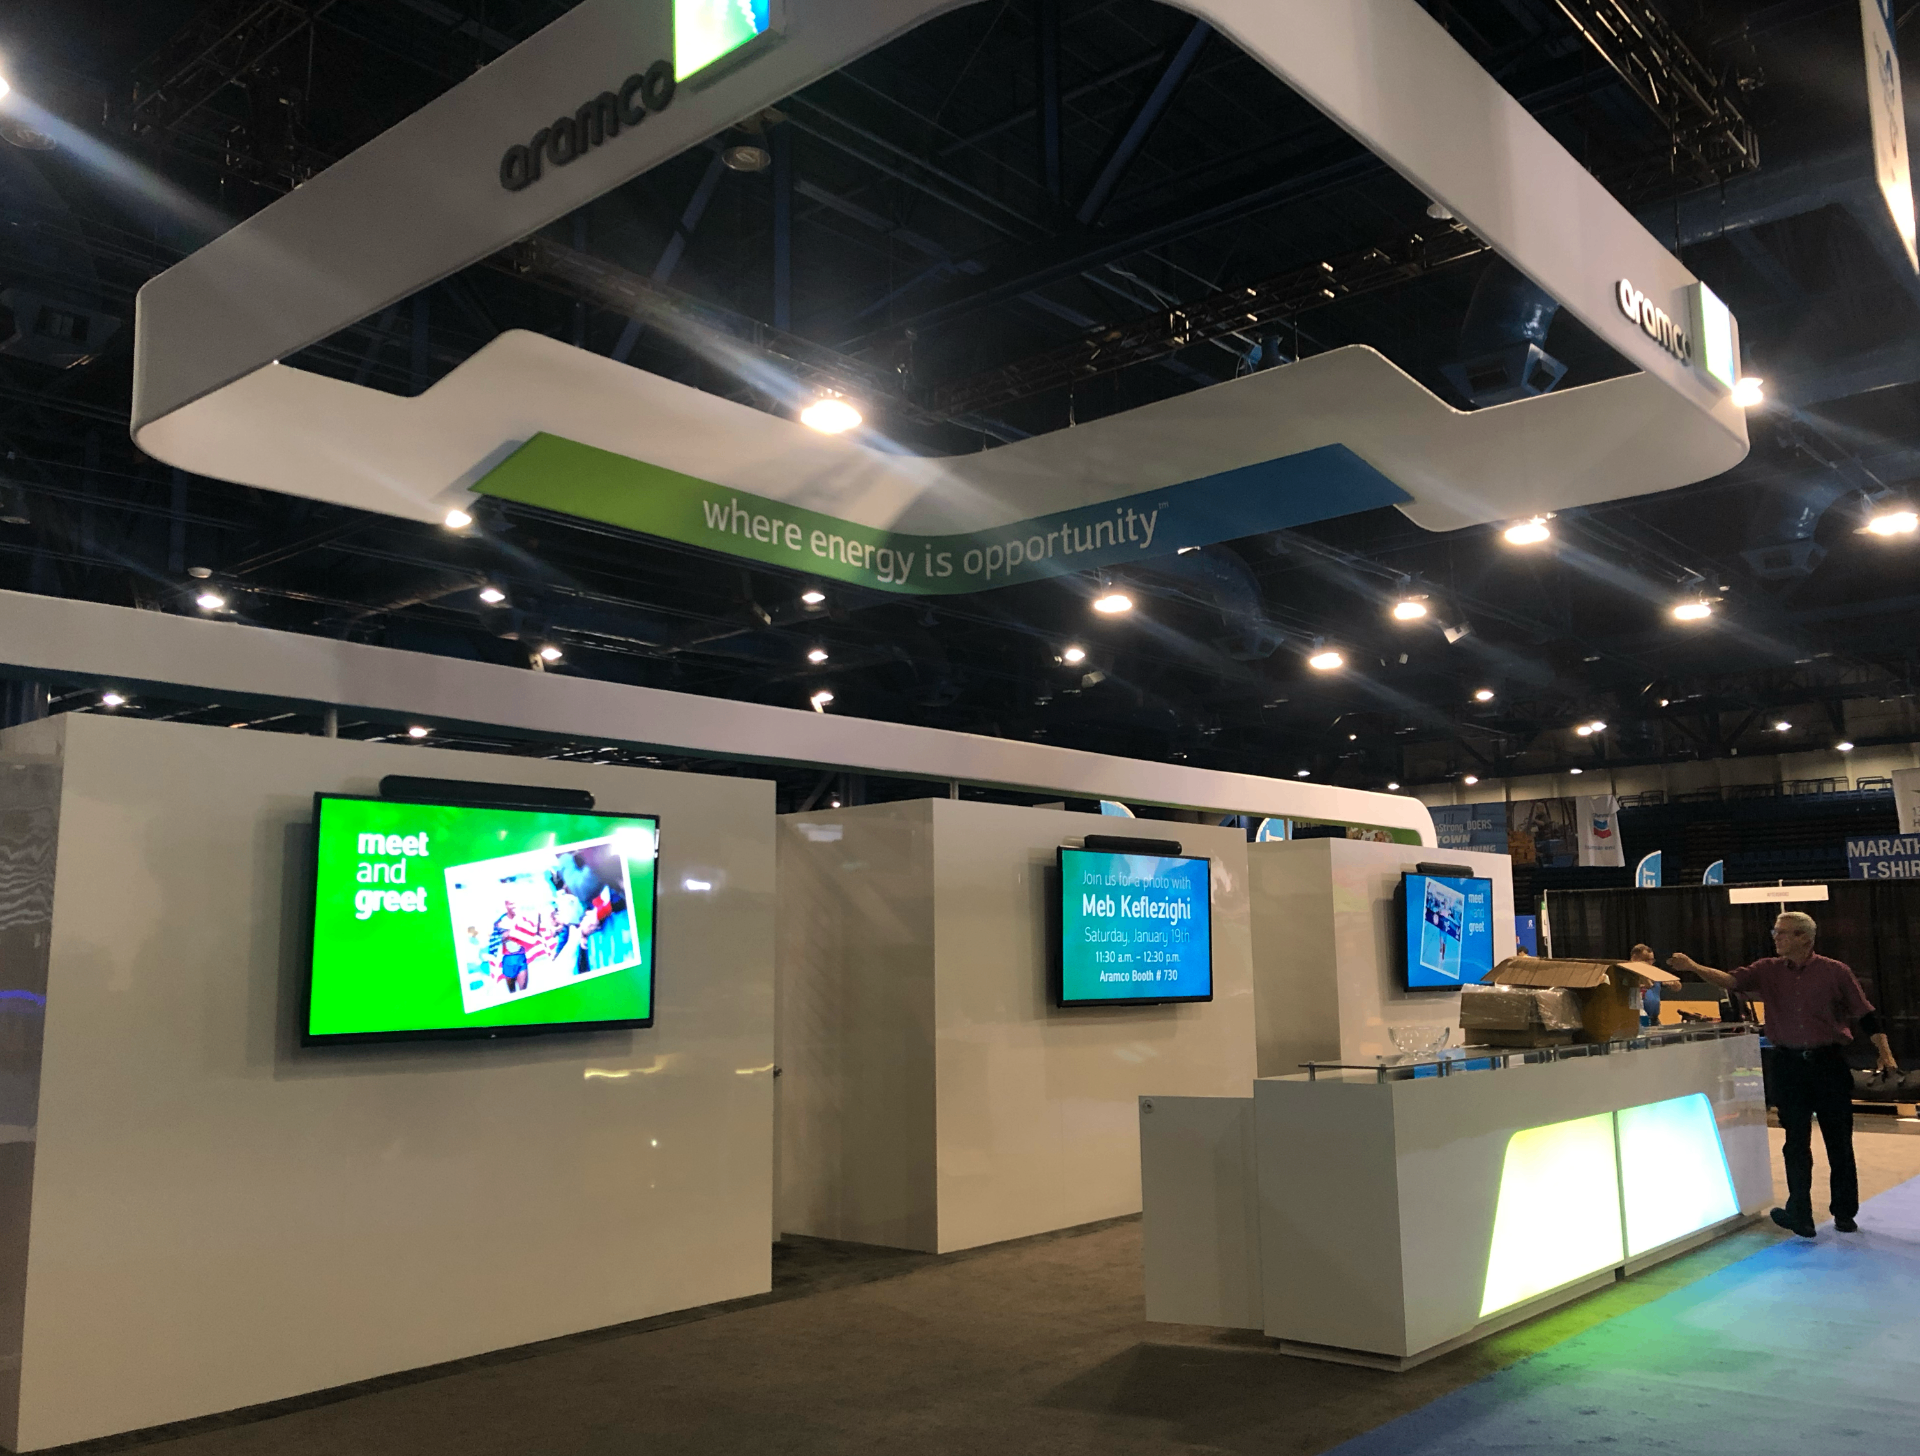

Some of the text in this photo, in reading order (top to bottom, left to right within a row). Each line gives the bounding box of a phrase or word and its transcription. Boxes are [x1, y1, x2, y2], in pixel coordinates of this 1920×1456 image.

[500, 59, 677, 191] aramco
[703, 498, 803, 550] where
[810, 530, 915, 584] energy
[925, 544, 953, 577] is
[963, 506, 1158, 580] opportunity
[1466, 819, 1493, 831] DOERS
[357, 832, 430, 857] meet
[1437, 834, 1471, 844] TOWN
[356, 858, 406, 884] and
[1859, 860, 1920, 879] T-SHIR
[1083, 870, 1192, 892] Join us for a photo with
[355, 887, 428, 920] greet
[1082, 893, 1192, 926] Meb Keflezighi
[1468, 893, 1484, 904] meet
[1084, 926, 1191, 948] Saturday, January 19th
[1468, 920, 1485, 936] greet
[1095, 951, 1116, 963] 11:30
[1117, 953, 1134, 963] a.m.
[1143, 951, 1164, 963] 12:30
[1165, 953, 1181, 965] p.m.
[1099, 969, 1130, 983] Aramco
[1131, 969, 1154, 982] Booth
[1163, 969, 1178, 981] 730
